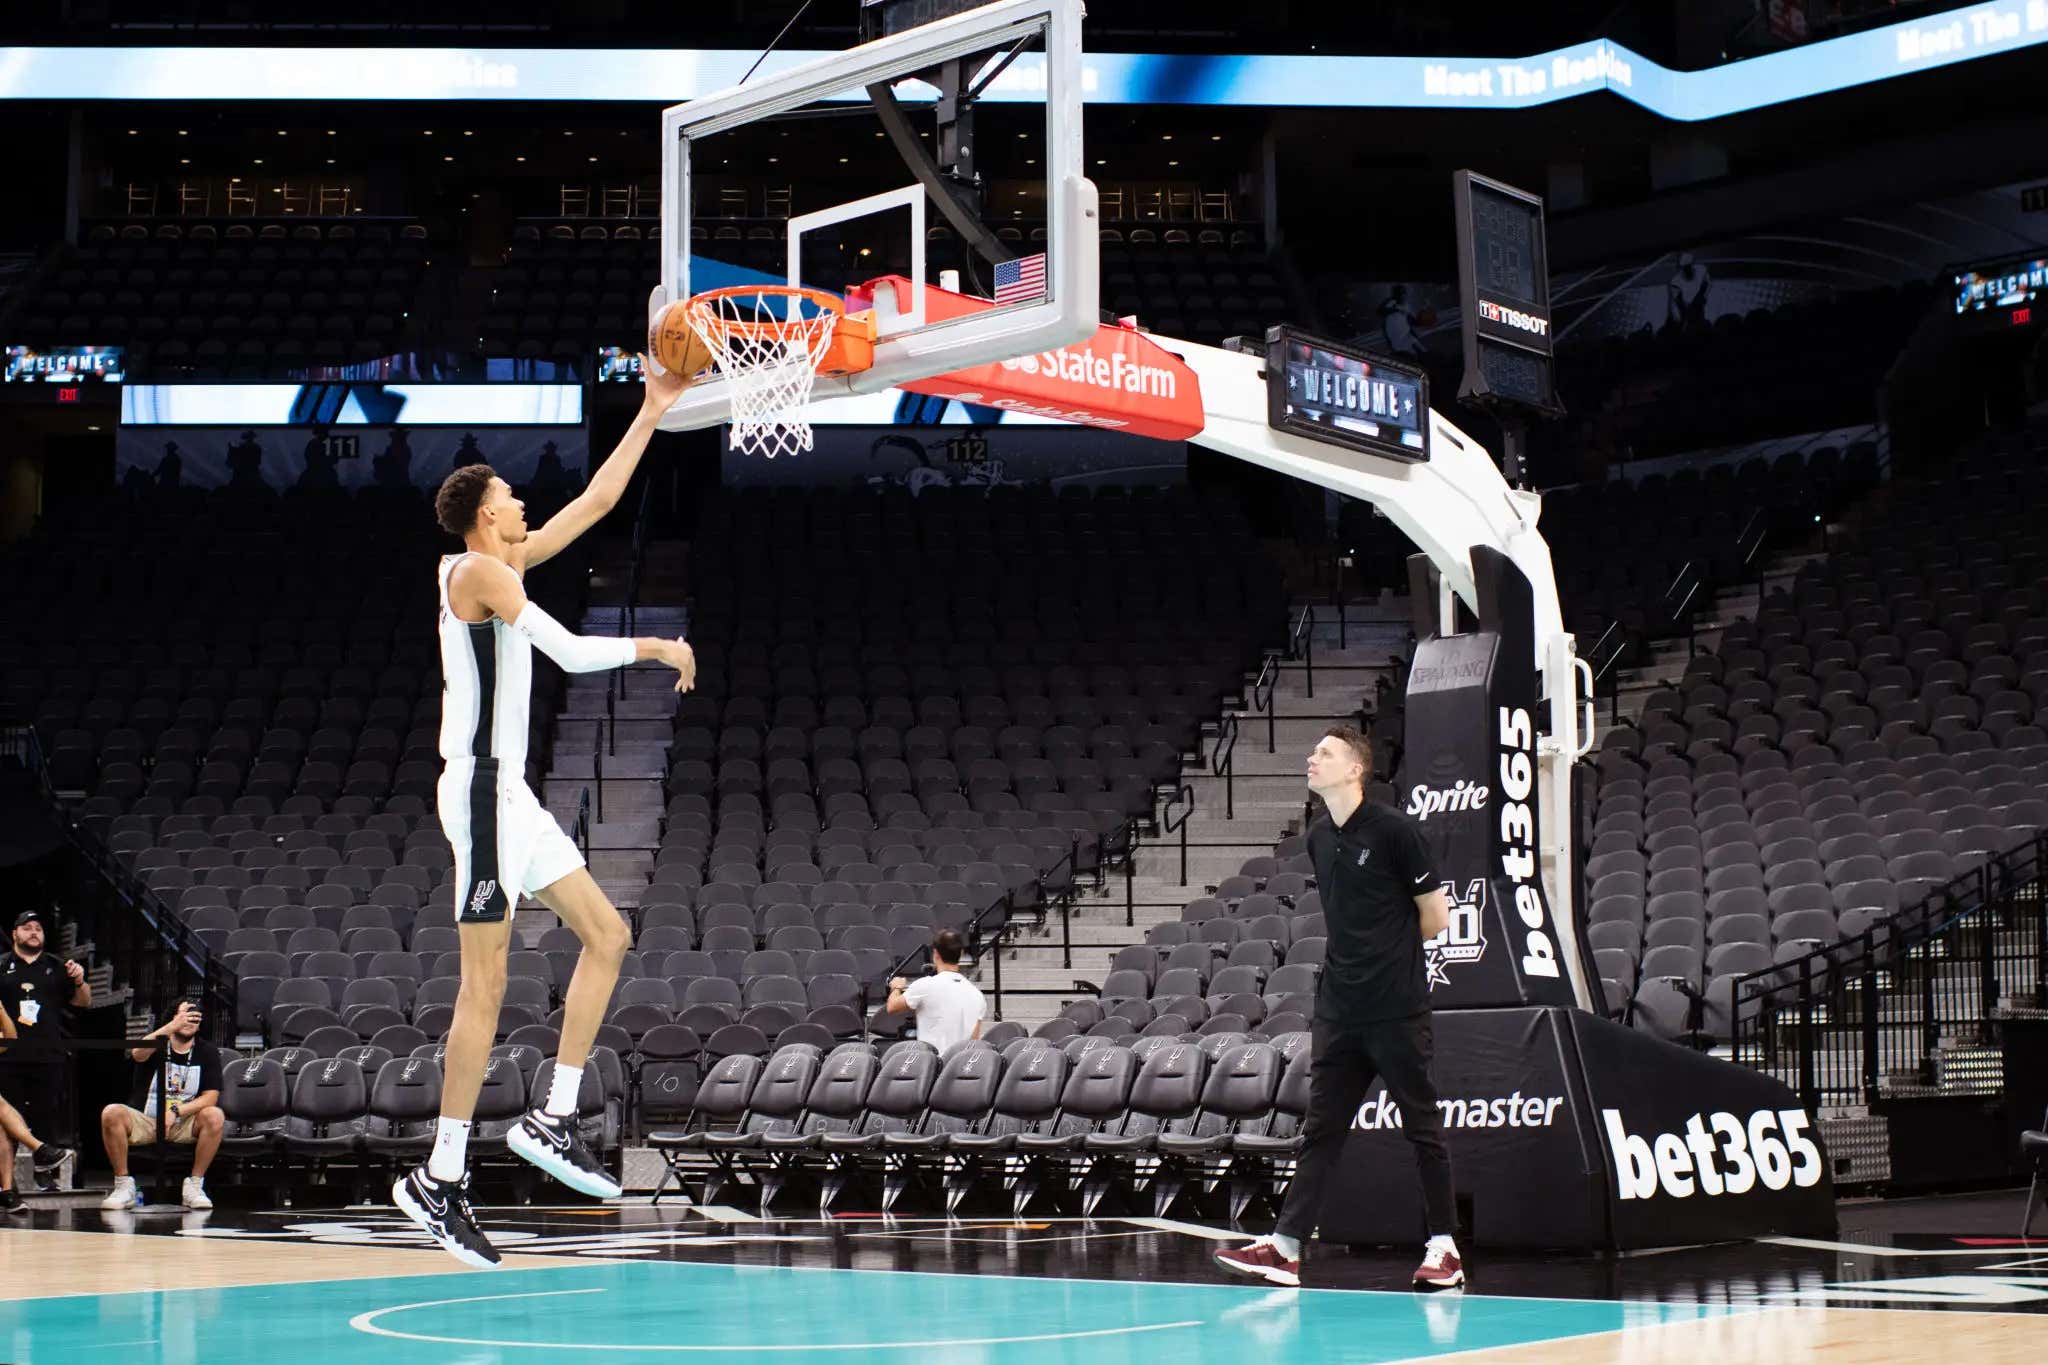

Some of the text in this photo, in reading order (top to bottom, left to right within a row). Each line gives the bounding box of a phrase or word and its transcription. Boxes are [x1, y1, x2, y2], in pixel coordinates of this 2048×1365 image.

[1499, 305, 1548, 336] TISSOT
[22, 355, 103, 376] WELCOME
[60, 389, 78, 401] EXIT
[1304, 368, 1399, 419] WELCOME
[322, 437, 356, 457] 111
[949, 440, 985, 461] 112
[1406, 779, 1489, 821] Sprite
[1499, 706, 1560, 978] bet365
[1350, 1090, 1563, 1129] ckmaster
[1602, 1108, 1822, 1200] bet365
